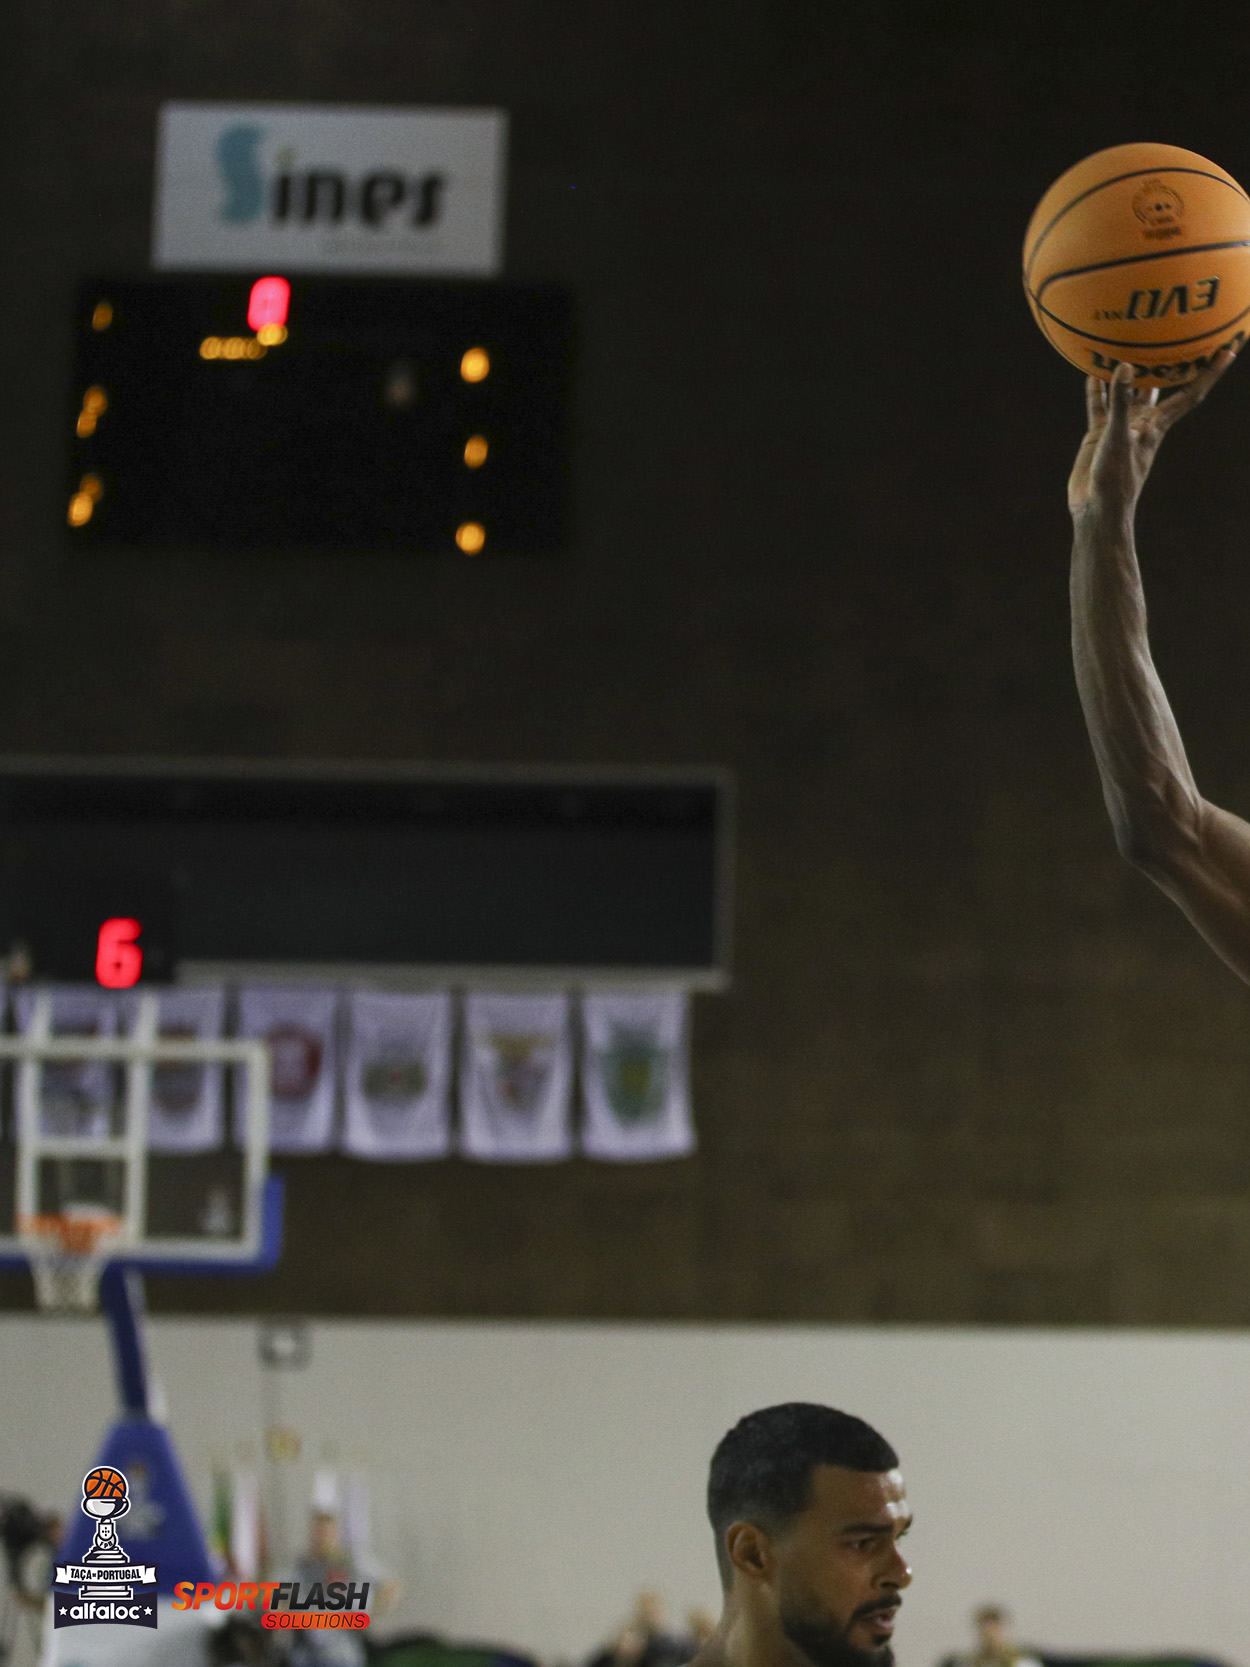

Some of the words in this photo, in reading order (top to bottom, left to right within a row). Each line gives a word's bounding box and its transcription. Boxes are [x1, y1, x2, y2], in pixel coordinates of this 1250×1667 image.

[213, 124, 445, 230] Sines
[1126, 276, 1220, 320] EVO
[95, 917, 143, 989] 6
